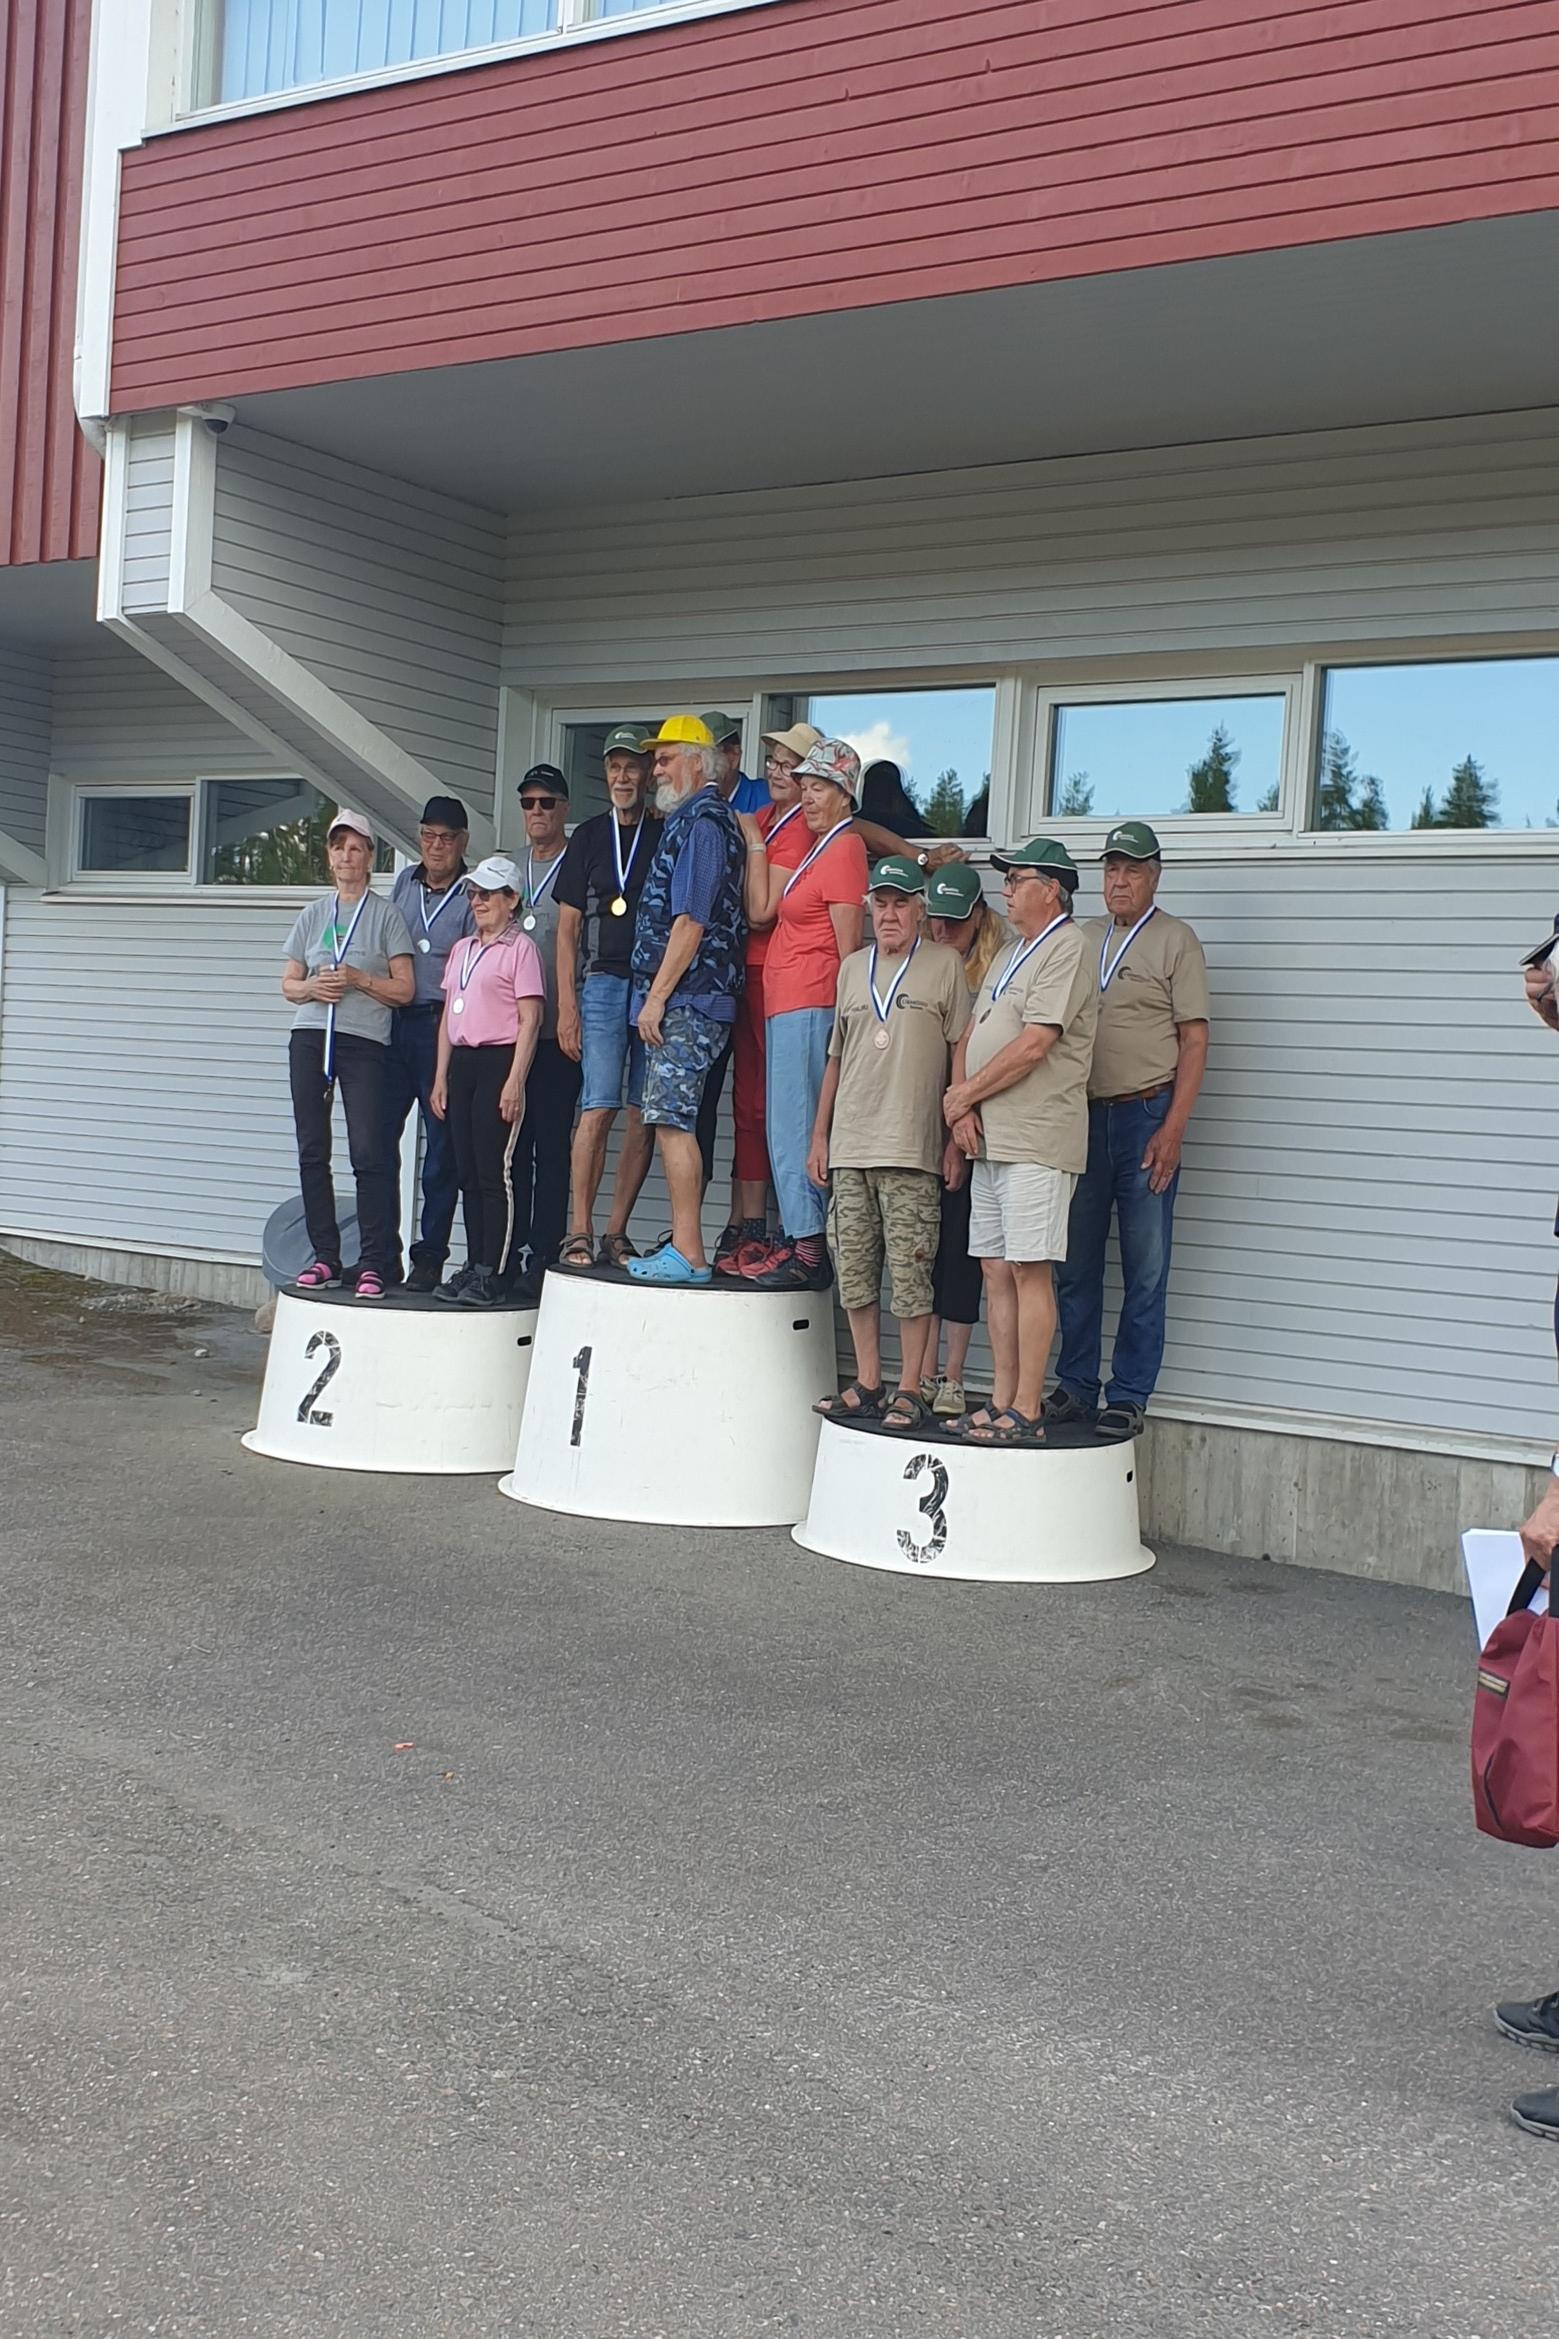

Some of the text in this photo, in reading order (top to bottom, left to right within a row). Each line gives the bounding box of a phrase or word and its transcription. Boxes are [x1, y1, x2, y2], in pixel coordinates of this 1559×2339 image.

[297, 1330, 341, 1427] 2
[570, 1346, 593, 1447] 1
[896, 1454, 949, 1563] 3
